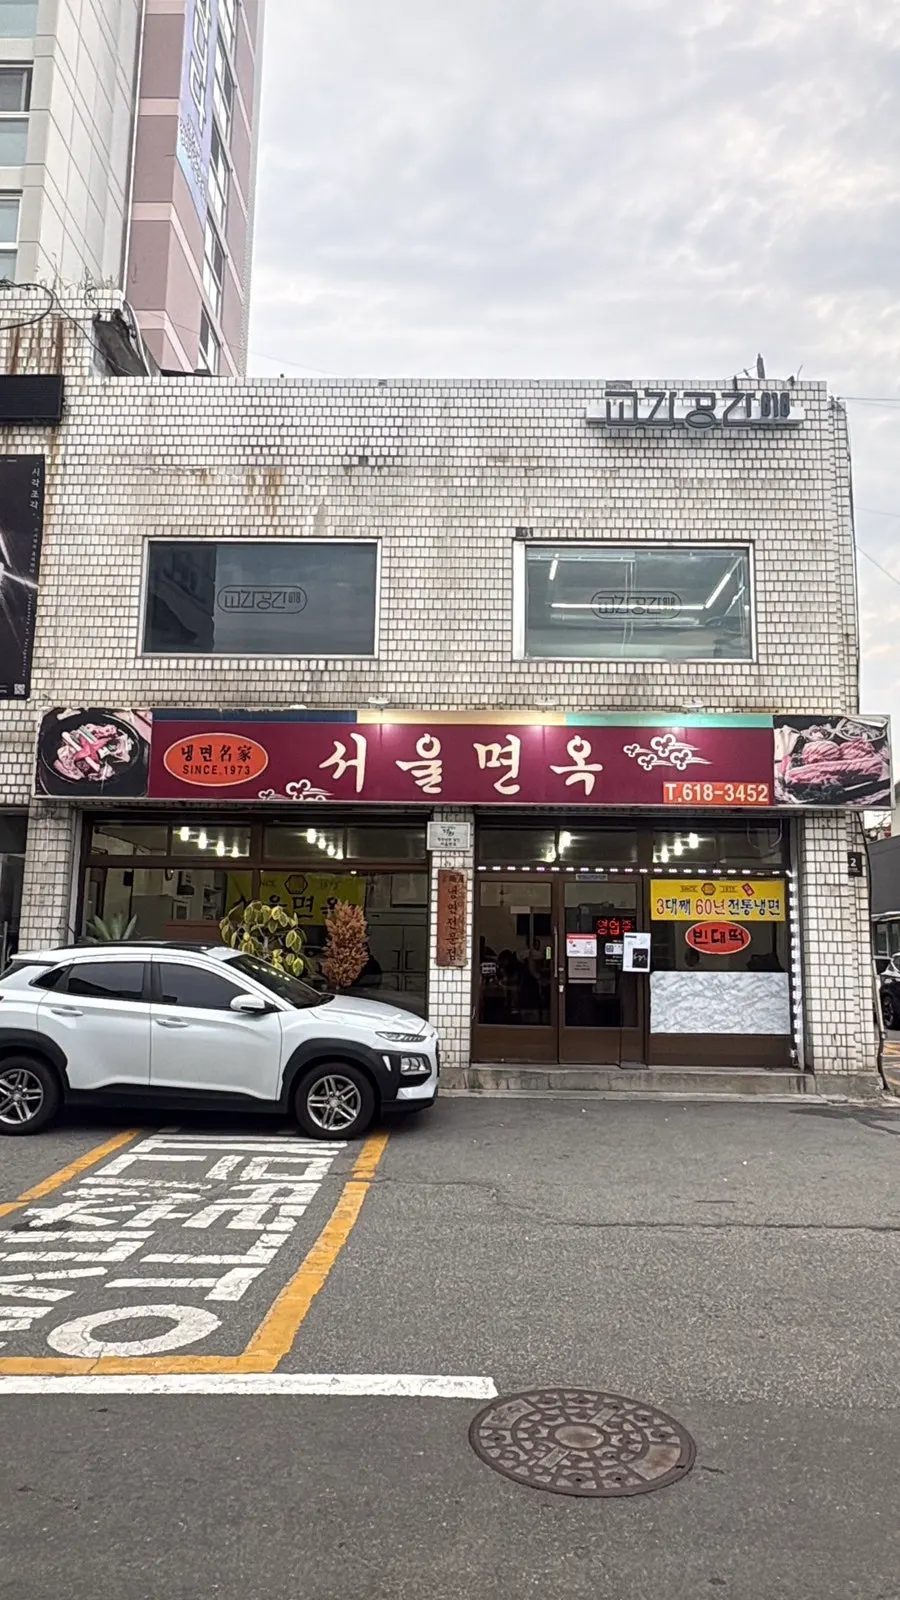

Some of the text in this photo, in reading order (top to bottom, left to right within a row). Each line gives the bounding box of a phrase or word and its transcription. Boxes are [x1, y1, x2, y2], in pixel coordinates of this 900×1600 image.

[180, 744, 252, 764] 냉면名家
[318, 731, 604, 797] 서울면옥
[665, 784, 768, 803] T.618-3452
[656, 898, 780, 916] 3대째 60년 전통냉면
[693, 928, 744, 945] 빈대떡
